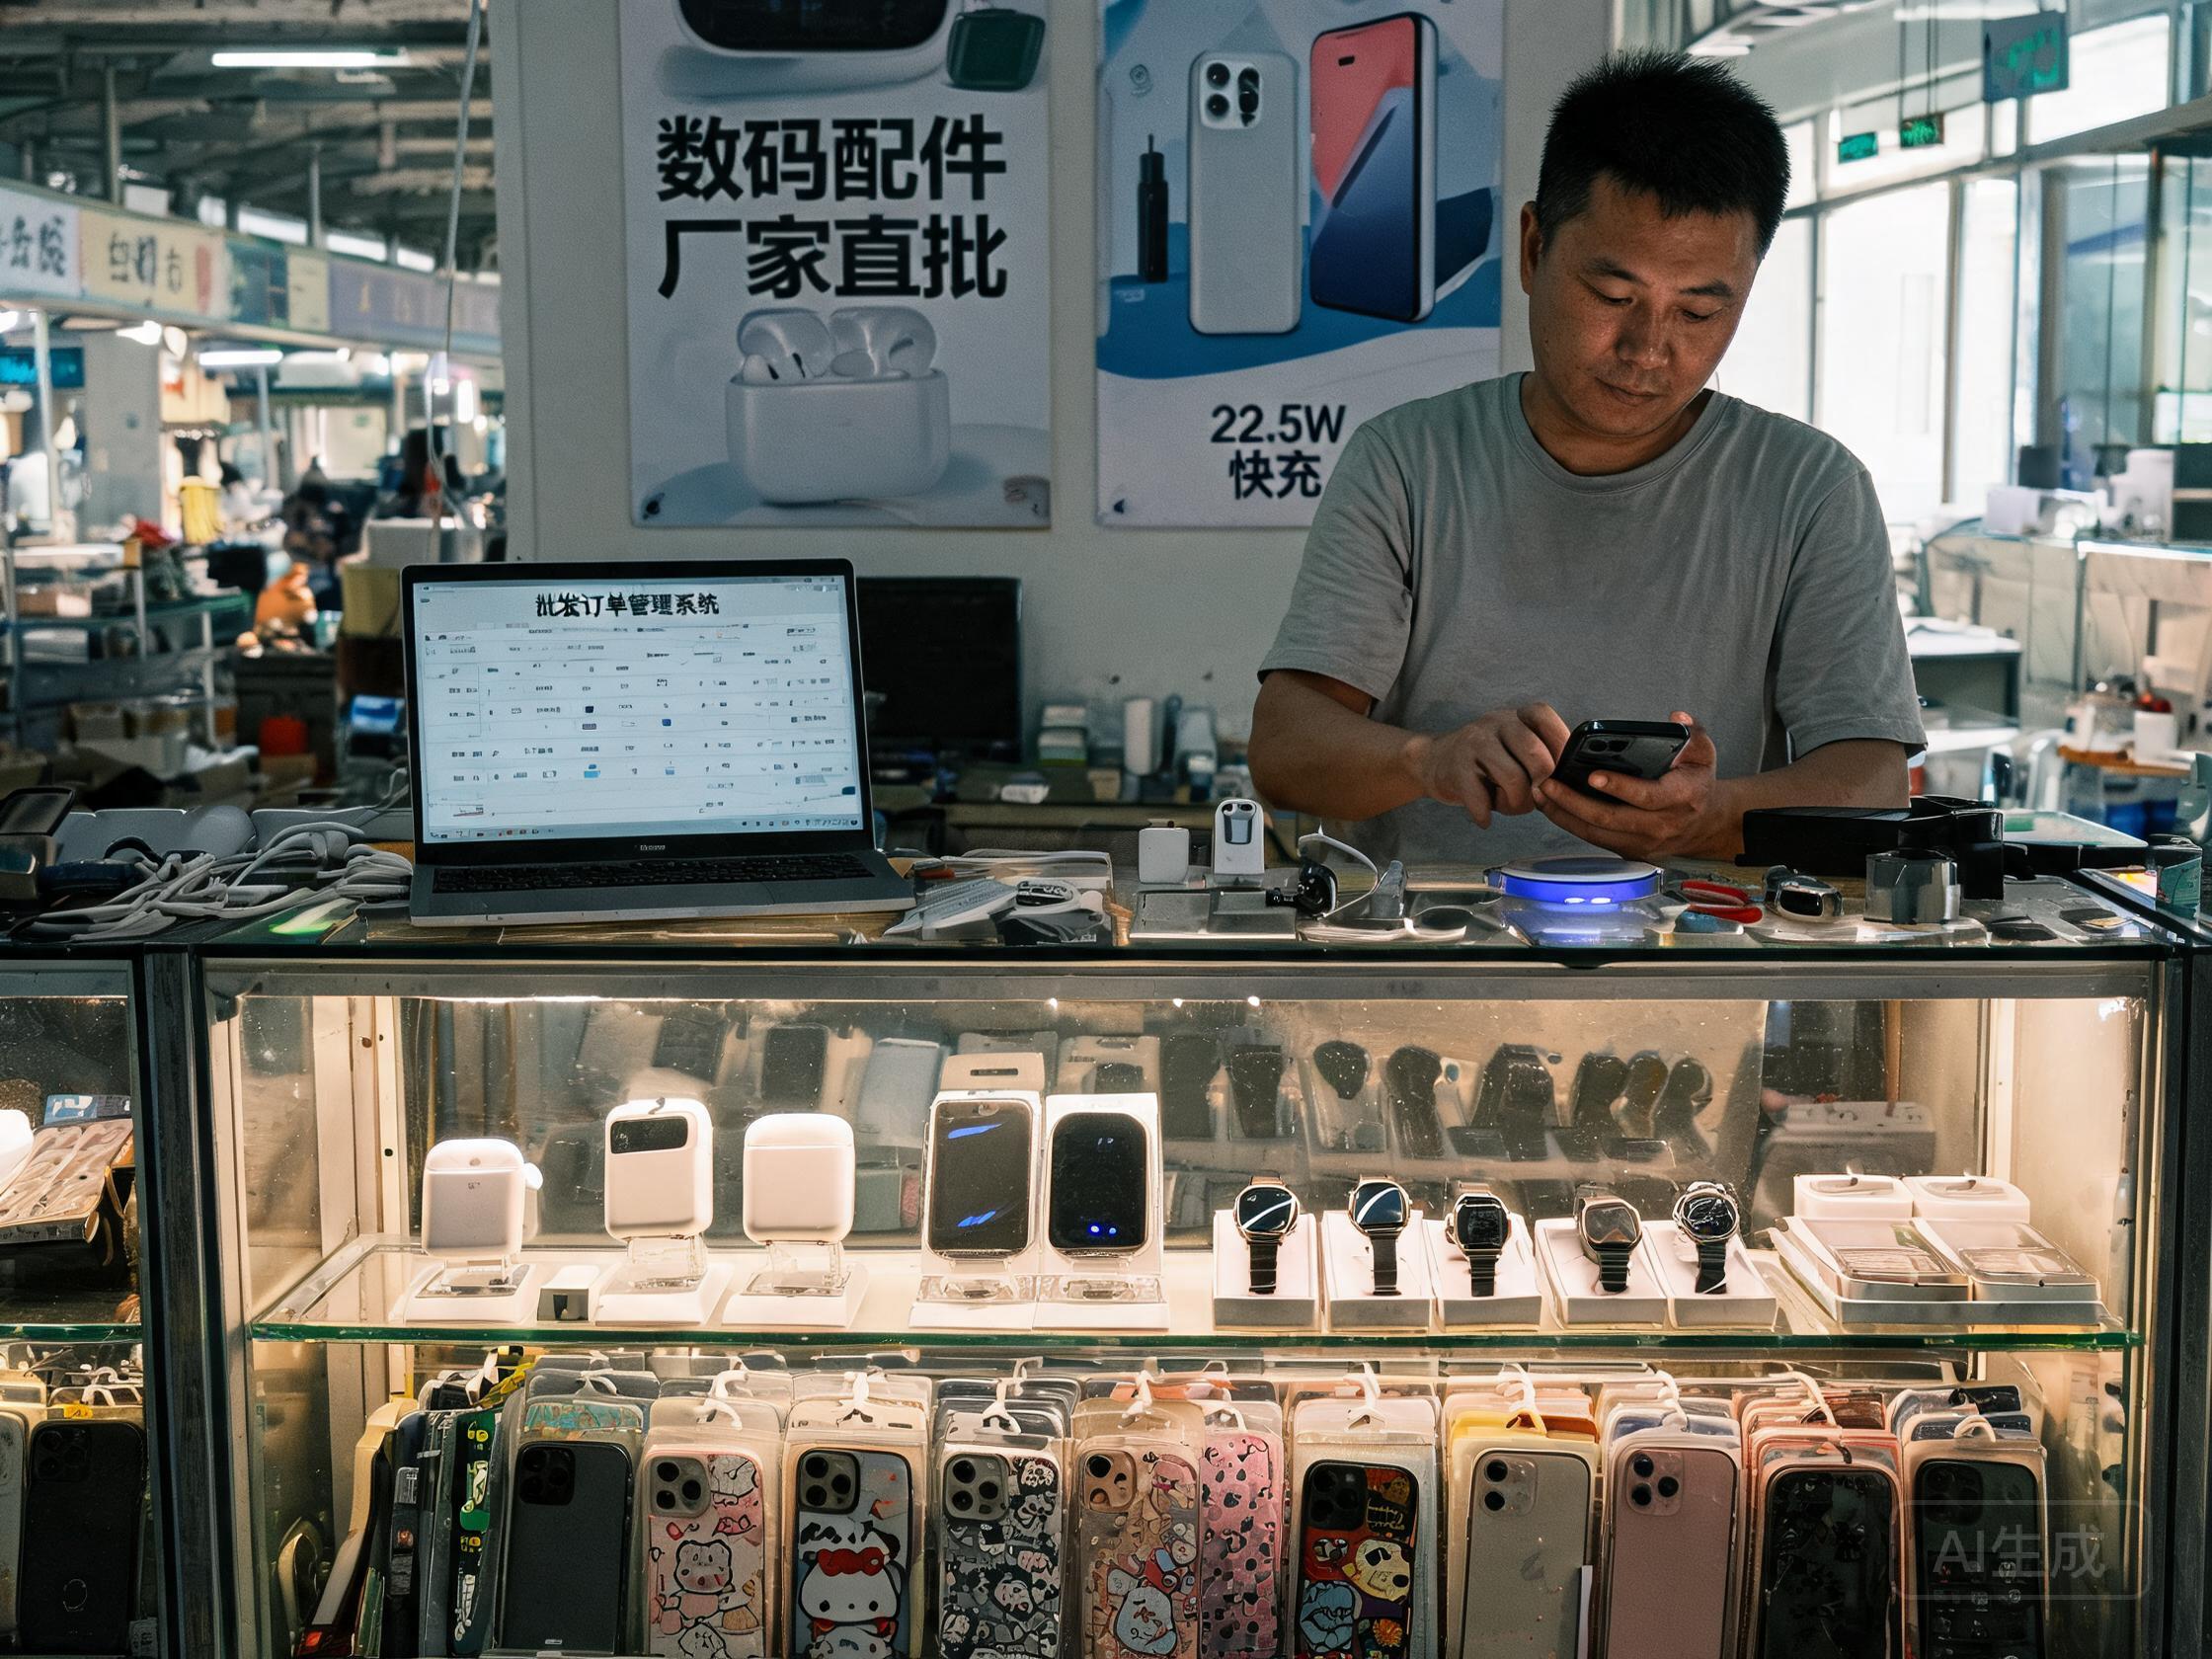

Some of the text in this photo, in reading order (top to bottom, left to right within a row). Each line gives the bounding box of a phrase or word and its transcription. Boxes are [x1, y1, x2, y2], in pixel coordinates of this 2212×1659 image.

[657, 114, 1007, 201] 数码配件
[658, 214, 1007, 299] 厂家直批
[1210, 403, 1346, 443] 22.5W
[1228, 449, 1322, 500] 快充
